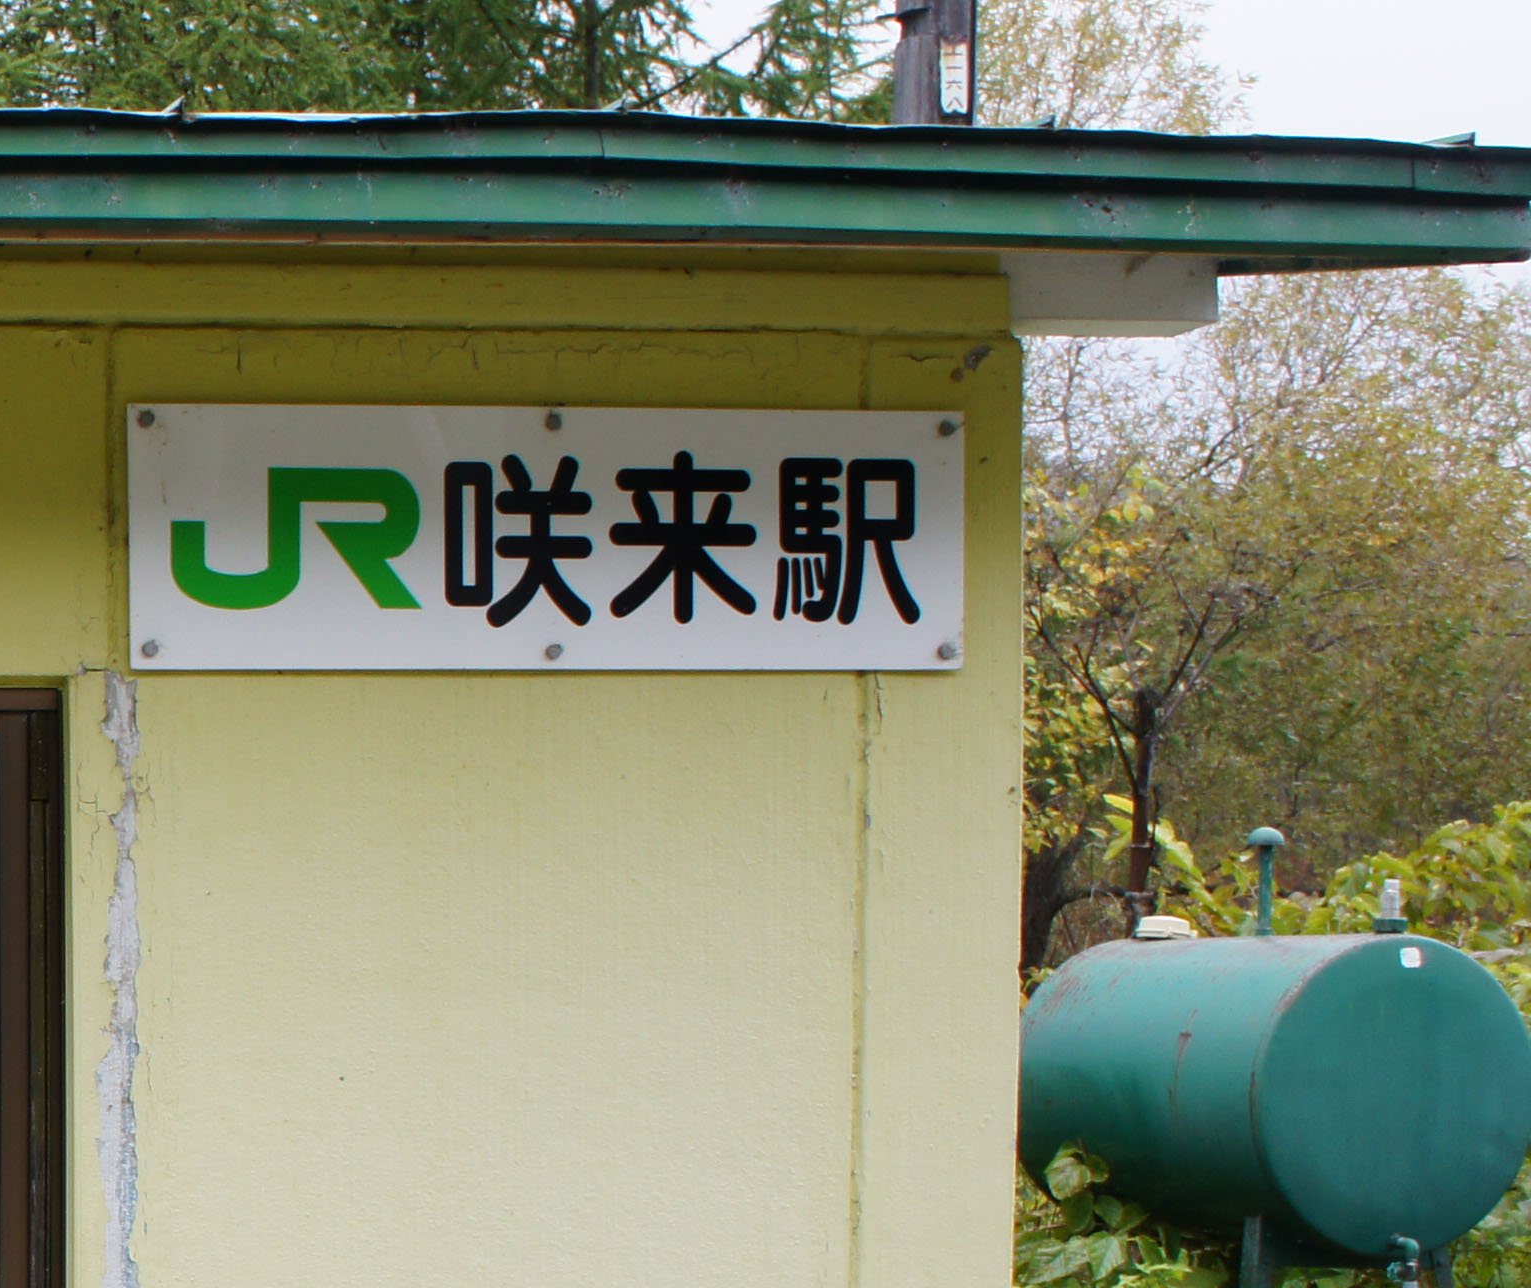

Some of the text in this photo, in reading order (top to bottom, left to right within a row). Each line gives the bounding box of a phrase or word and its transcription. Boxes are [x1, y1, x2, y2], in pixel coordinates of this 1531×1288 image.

[170, 450, 920, 627] JR 咲来駅
